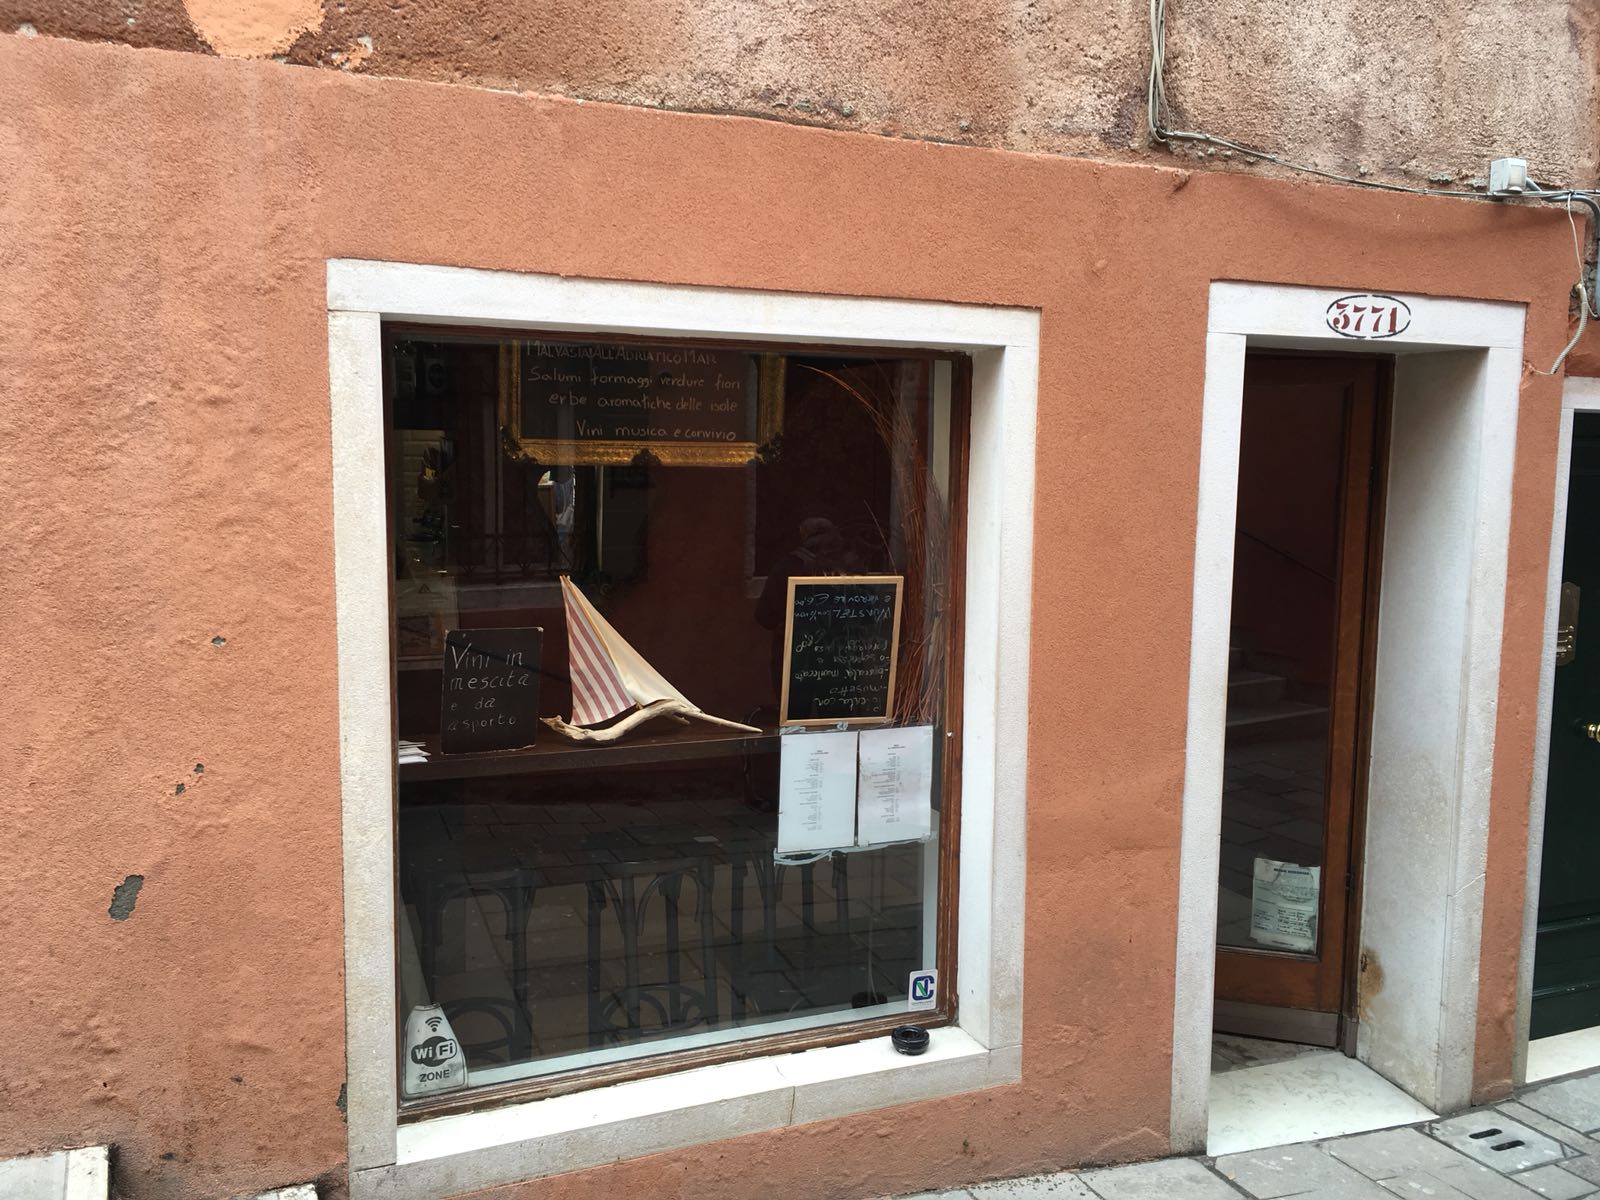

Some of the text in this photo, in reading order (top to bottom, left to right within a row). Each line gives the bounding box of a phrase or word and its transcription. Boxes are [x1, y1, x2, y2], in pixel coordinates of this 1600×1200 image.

[1333, 302, 1397, 333] 3771
[527, 367, 741, 390] Salumi formaggi verdure fiori
[548, 390, 738, 413] erbe aromatiche delle isole
[576, 419, 737, 442] Vini musica e convivio
[451, 642, 523, 669] Vini in
[450, 669, 529, 691] mescita
[450, 697, 496, 711] e da
[447, 714, 517, 733] asporto
[419, 1069, 450, 1083] ZONE
